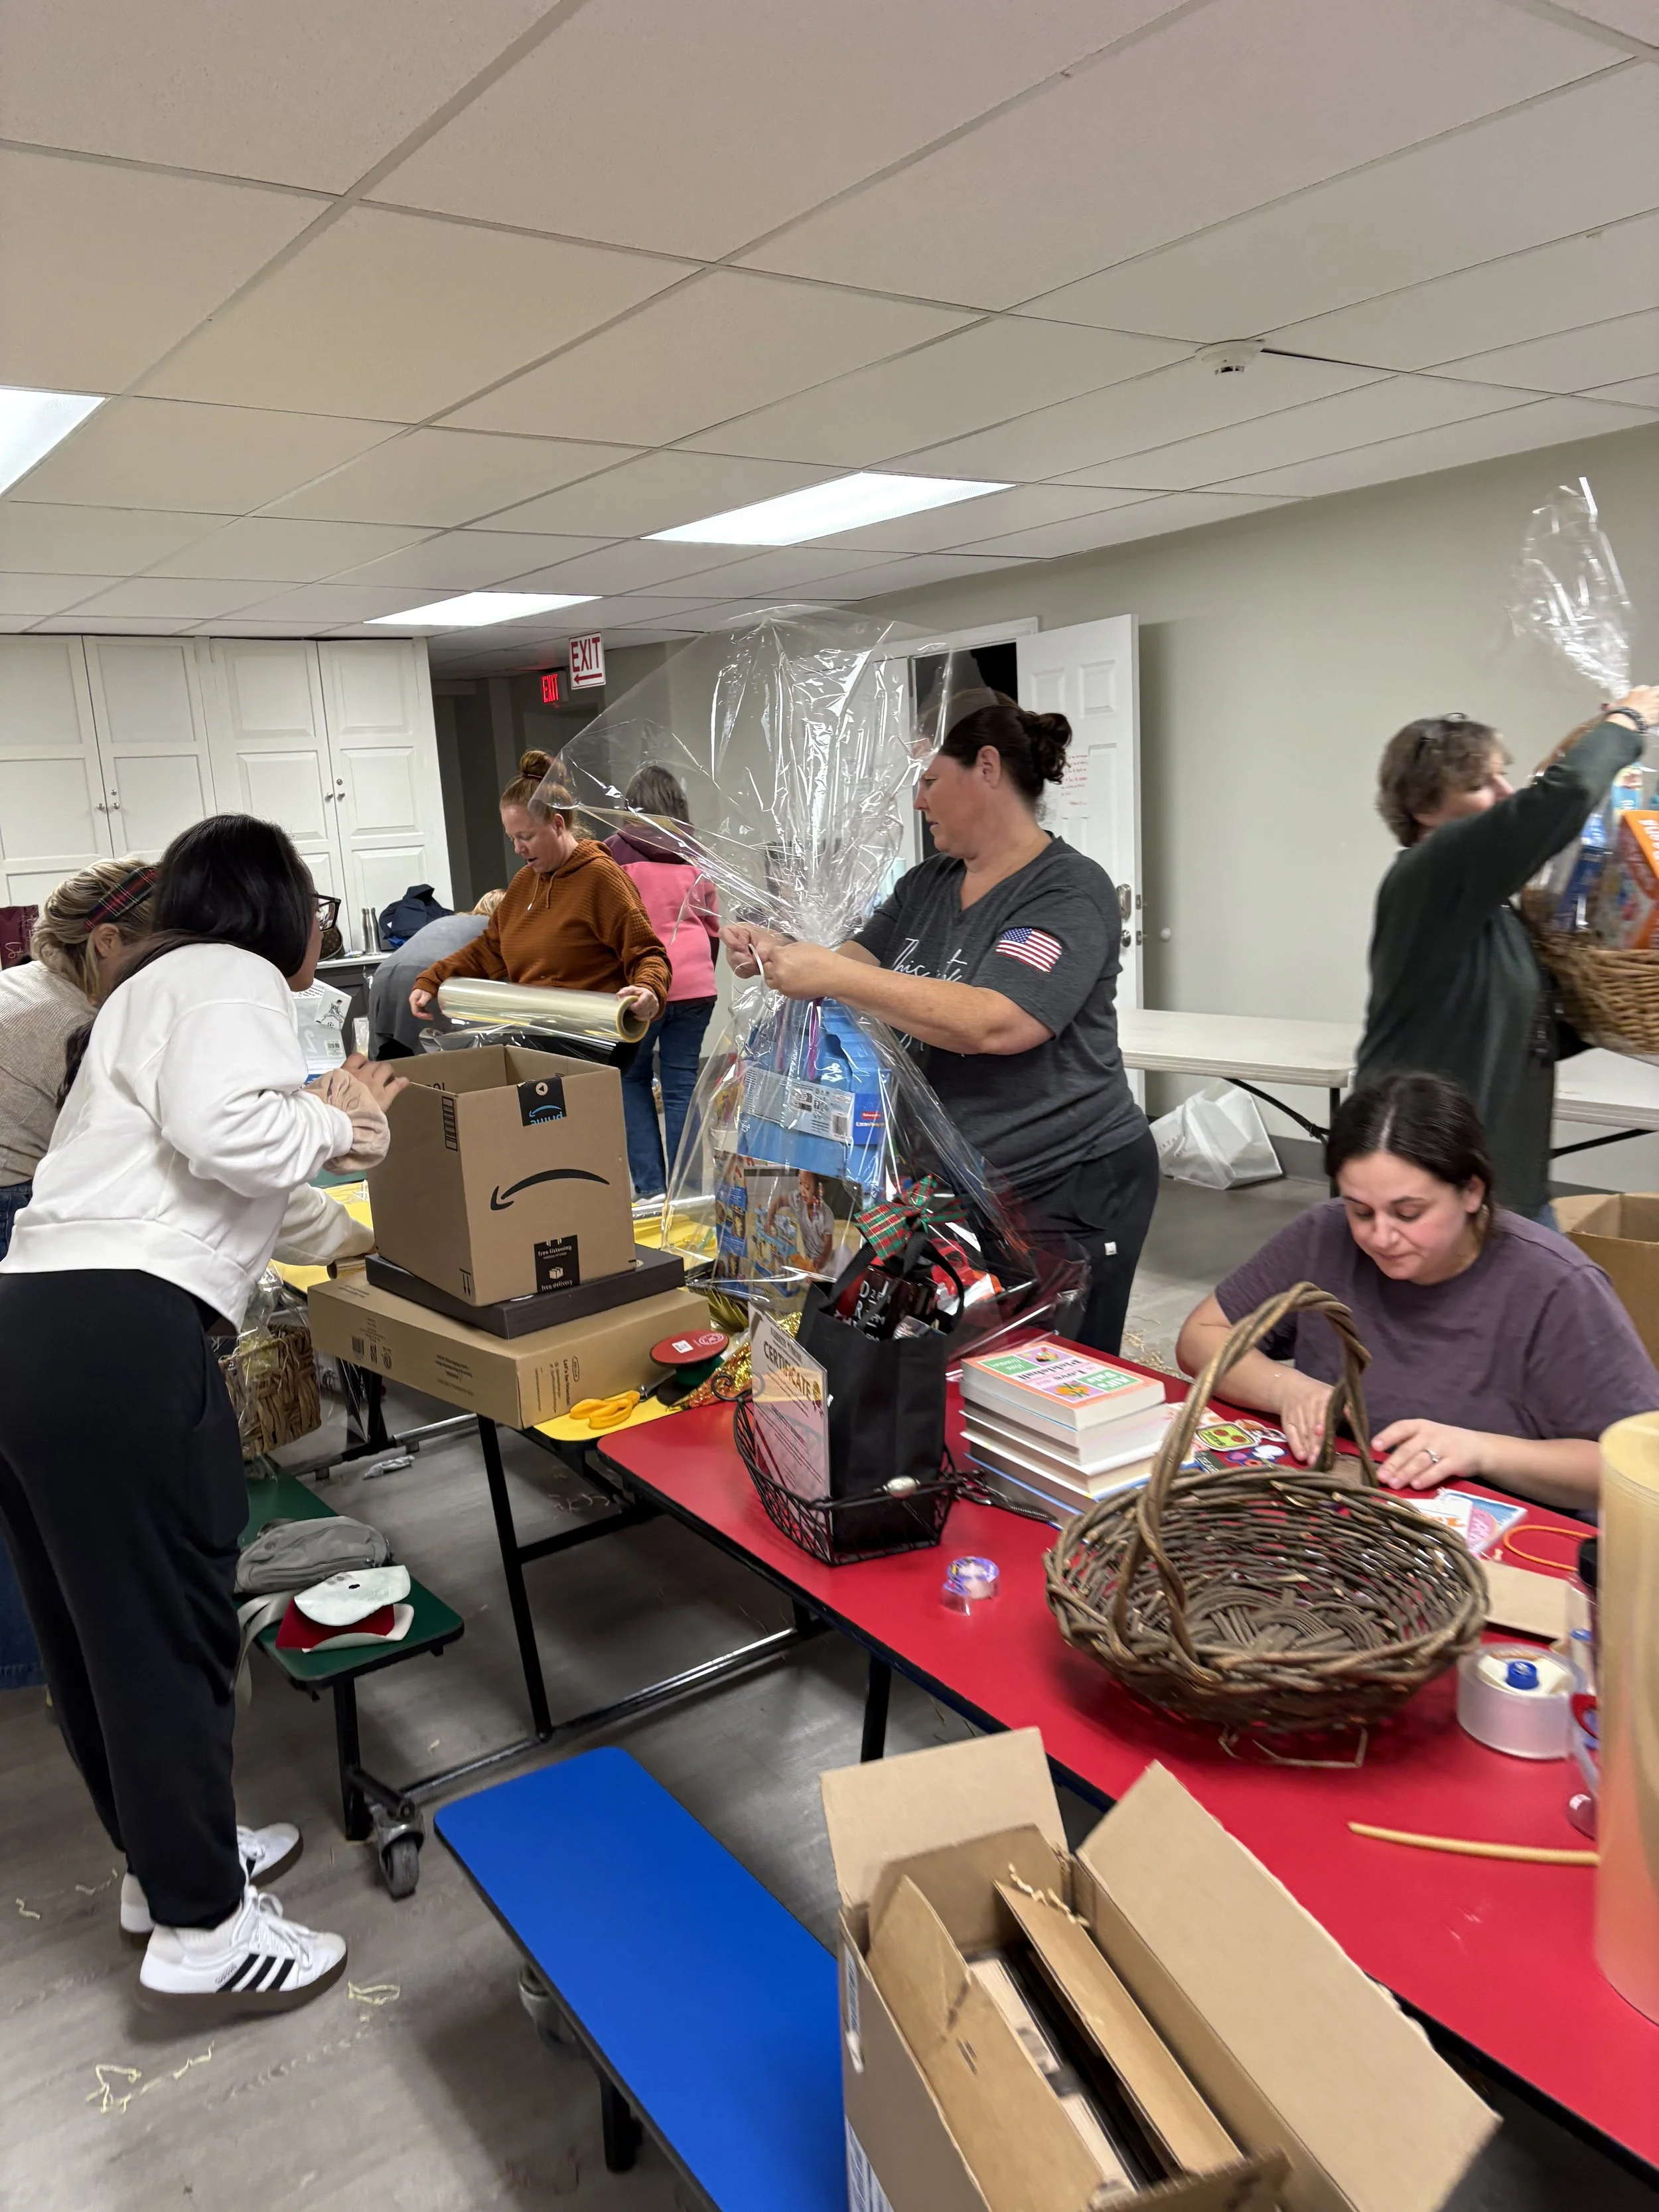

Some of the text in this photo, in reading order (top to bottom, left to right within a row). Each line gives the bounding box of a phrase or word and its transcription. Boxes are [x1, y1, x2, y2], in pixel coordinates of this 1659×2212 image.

[571, 637, 600, 672] EXIT
[541, 674, 559, 703] EXIT
[763, 1341, 812, 1402] CERTIFICATE
